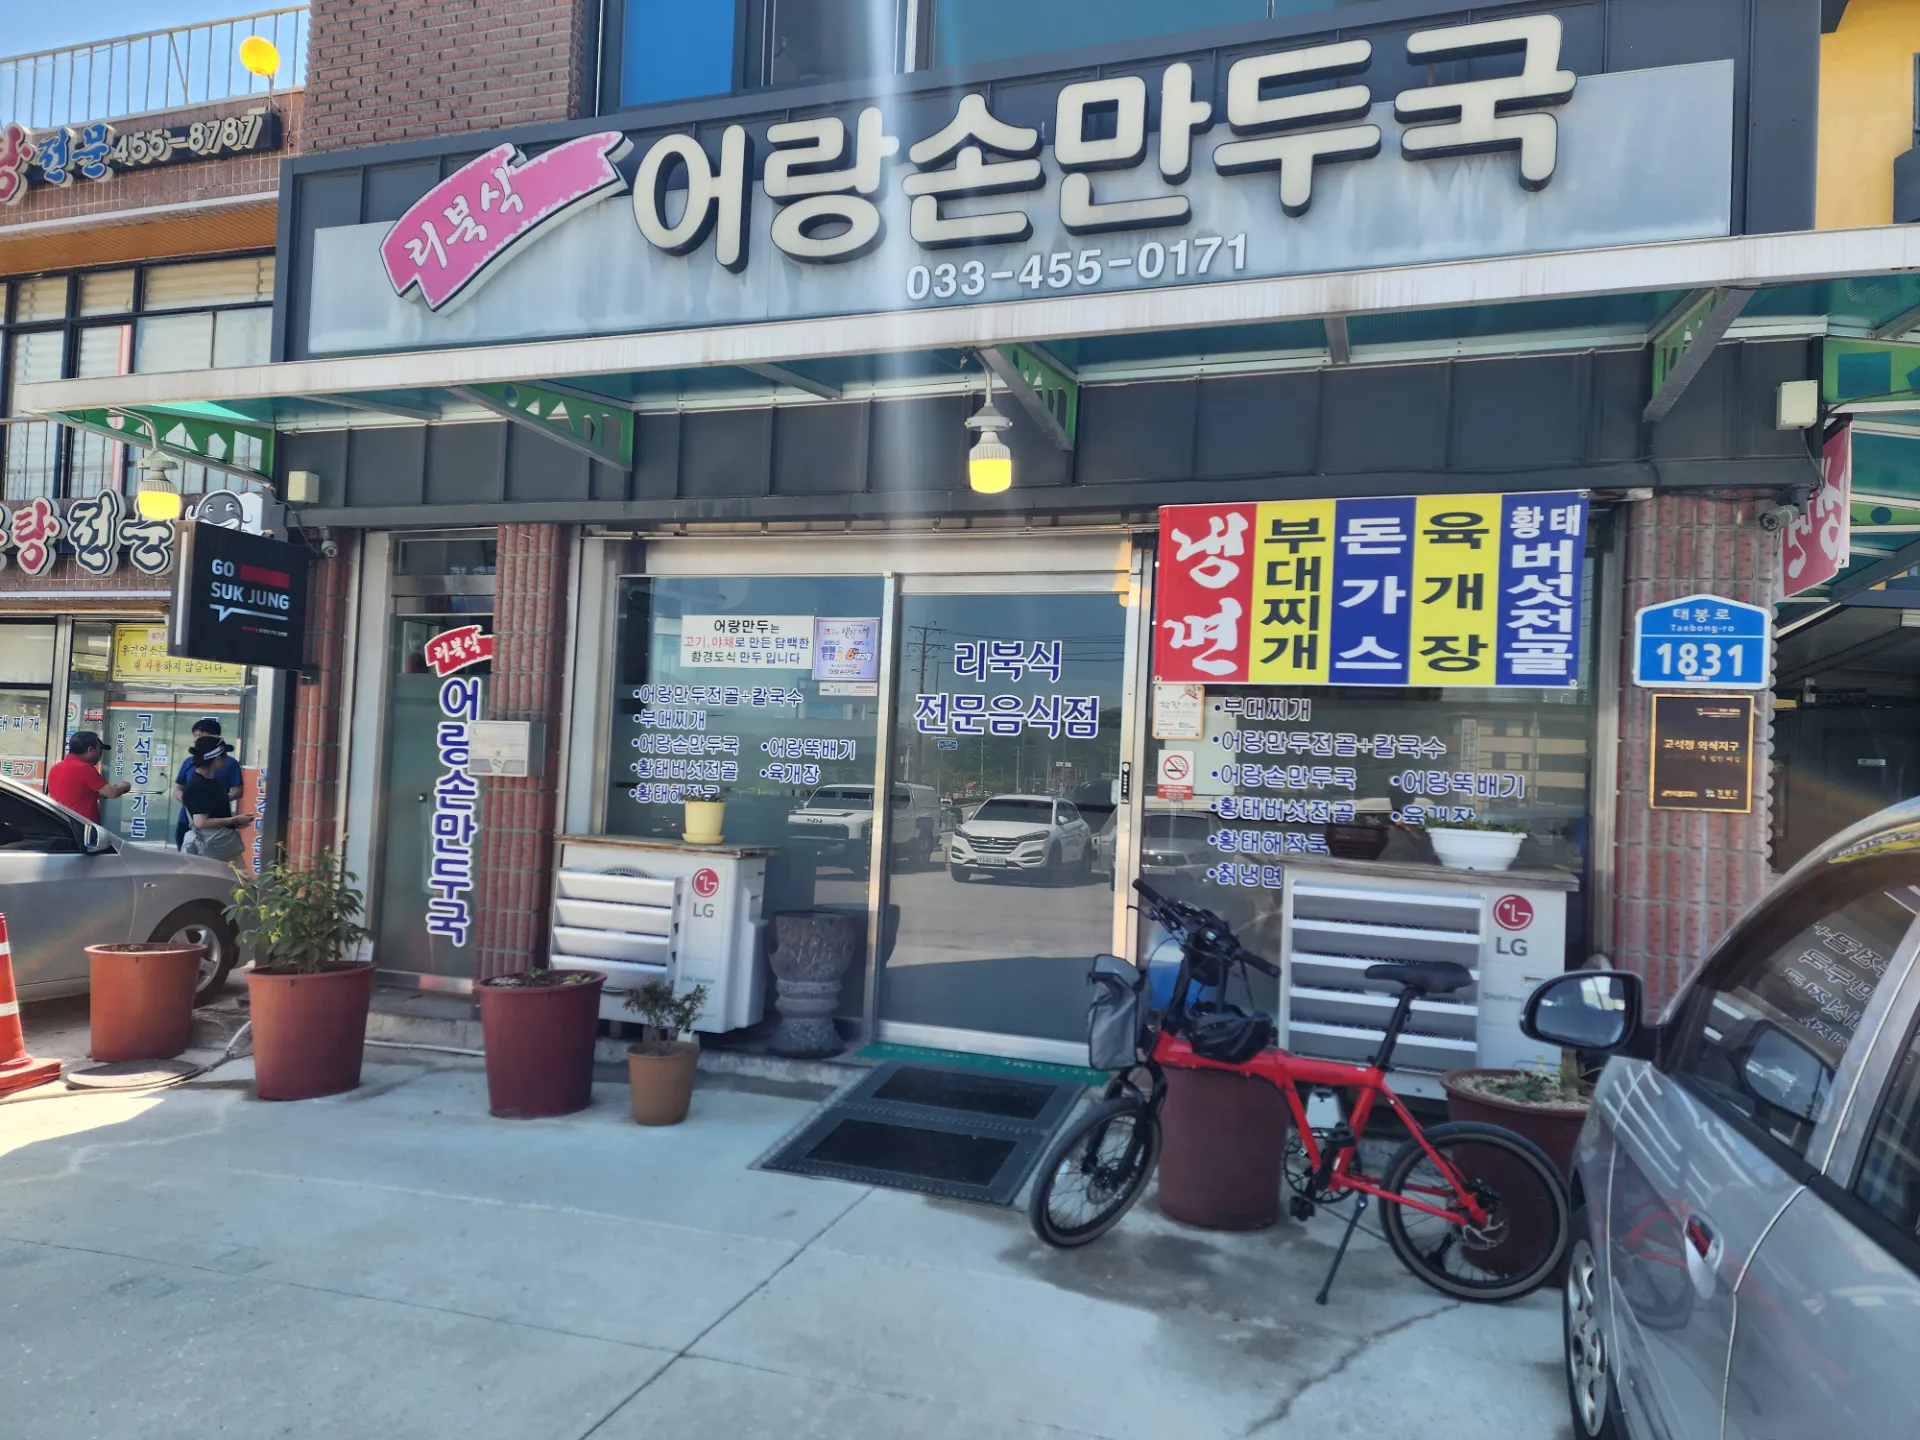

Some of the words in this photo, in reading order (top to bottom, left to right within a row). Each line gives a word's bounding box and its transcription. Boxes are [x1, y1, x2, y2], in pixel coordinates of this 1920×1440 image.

[112, 114, 262, 164] 455-8787
[632, 13, 1577, 272] 어랑손만두국
[403, 166, 525, 270] 리북식
[905, 233, 1247, 300] 033-455-0171
[1510, 505, 1582, 539] 황태
[211, 558, 234, 577] GO
[210, 581, 244, 602] SUK
[247, 588, 290, 610] JUNG
[1163, 512, 1249, 676] 냉면
[1261, 517, 1326, 671] 부대찌개
[1335, 517, 1407, 669] 돈가스
[1419, 511, 1490, 672] 육개장
[1504, 540, 1574, 676] 버섯전골
[714, 619, 780, 634] 어랑만두는
[1670, 624, 1735, 634] Taebong-ro
[1672, 608, 1731, 623] 태봉로
[740, 652, 762, 664] 만두
[766, 653, 801, 665] 입니다
[749, 637, 771, 649] 만든
[775, 638, 810, 650] 담백한
[1656, 642, 1744, 677] 1831
[953, 640, 1063, 684] 리북식
[640, 709, 707, 730] 부대찌개
[913, 692, 1100, 740] 전문음식점
[1223, 698, 1311, 721] 부대찌개
[132, 714, 154, 785] 고석정
[638, 733, 740, 755] 어랑손만두국
[768, 738, 856, 761] 어랑뚝배기
[636, 758, 739, 781] 황태버섯전골
[767, 762, 821, 785] 육개장
[1219, 763, 1358, 791] 어랑손만두국
[1402, 769, 1526, 799] 어랑뚝배기
[130, 794, 148, 838] 가든
[1218, 796, 1356, 824] 황태버섯전골
[692, 902, 715, 918] LG
[1495, 936, 1529, 957] LG
